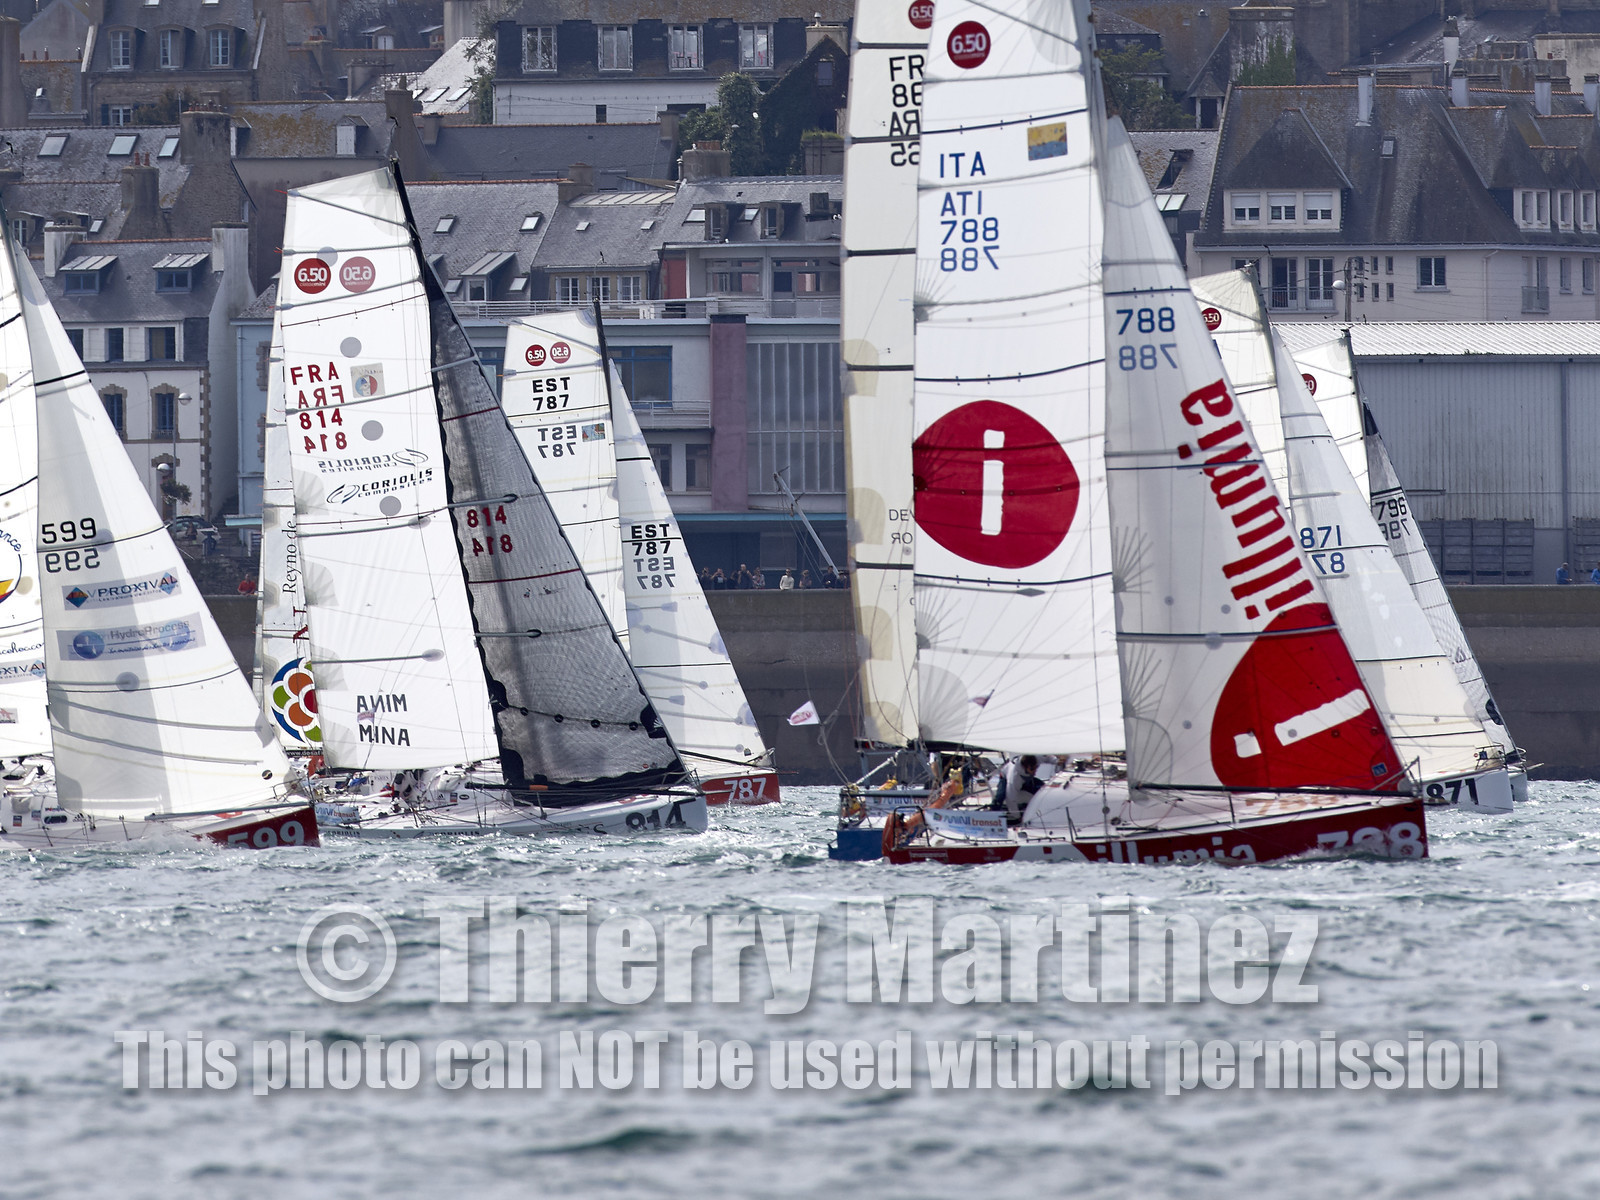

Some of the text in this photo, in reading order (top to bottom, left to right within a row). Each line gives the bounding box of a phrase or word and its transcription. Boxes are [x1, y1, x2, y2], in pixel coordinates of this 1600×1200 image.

[951, 32, 987, 53] 6.50
[889, 55, 924, 81] FR
[940, 151, 986, 178] ITA
[940, 217, 999, 244] 788
[297, 267, 328, 282] 6.50
[1116, 307, 1175, 335] 788
[290, 361, 339, 385] FRA
[532, 376, 570, 393] EST
[532, 393, 569, 411] 787
[299, 408, 343, 430] 814
[361, 467, 433, 492] CORIOLIS
[466, 505, 507, 529] 814
[1375, 497, 1407, 520] 796
[41, 517, 98, 545] 599
[631, 523, 670, 540] EST
[1300, 524, 1343, 549] 871
[632, 540, 671, 557] 787
[282, 543, 302, 594] Reyno
[359, 723, 411, 747] MINA
[724, 777, 767, 801] 787
[1426, 777, 1479, 805] 871
[227, 820, 305, 849] 599
[971, 818, 1003, 827] transat
